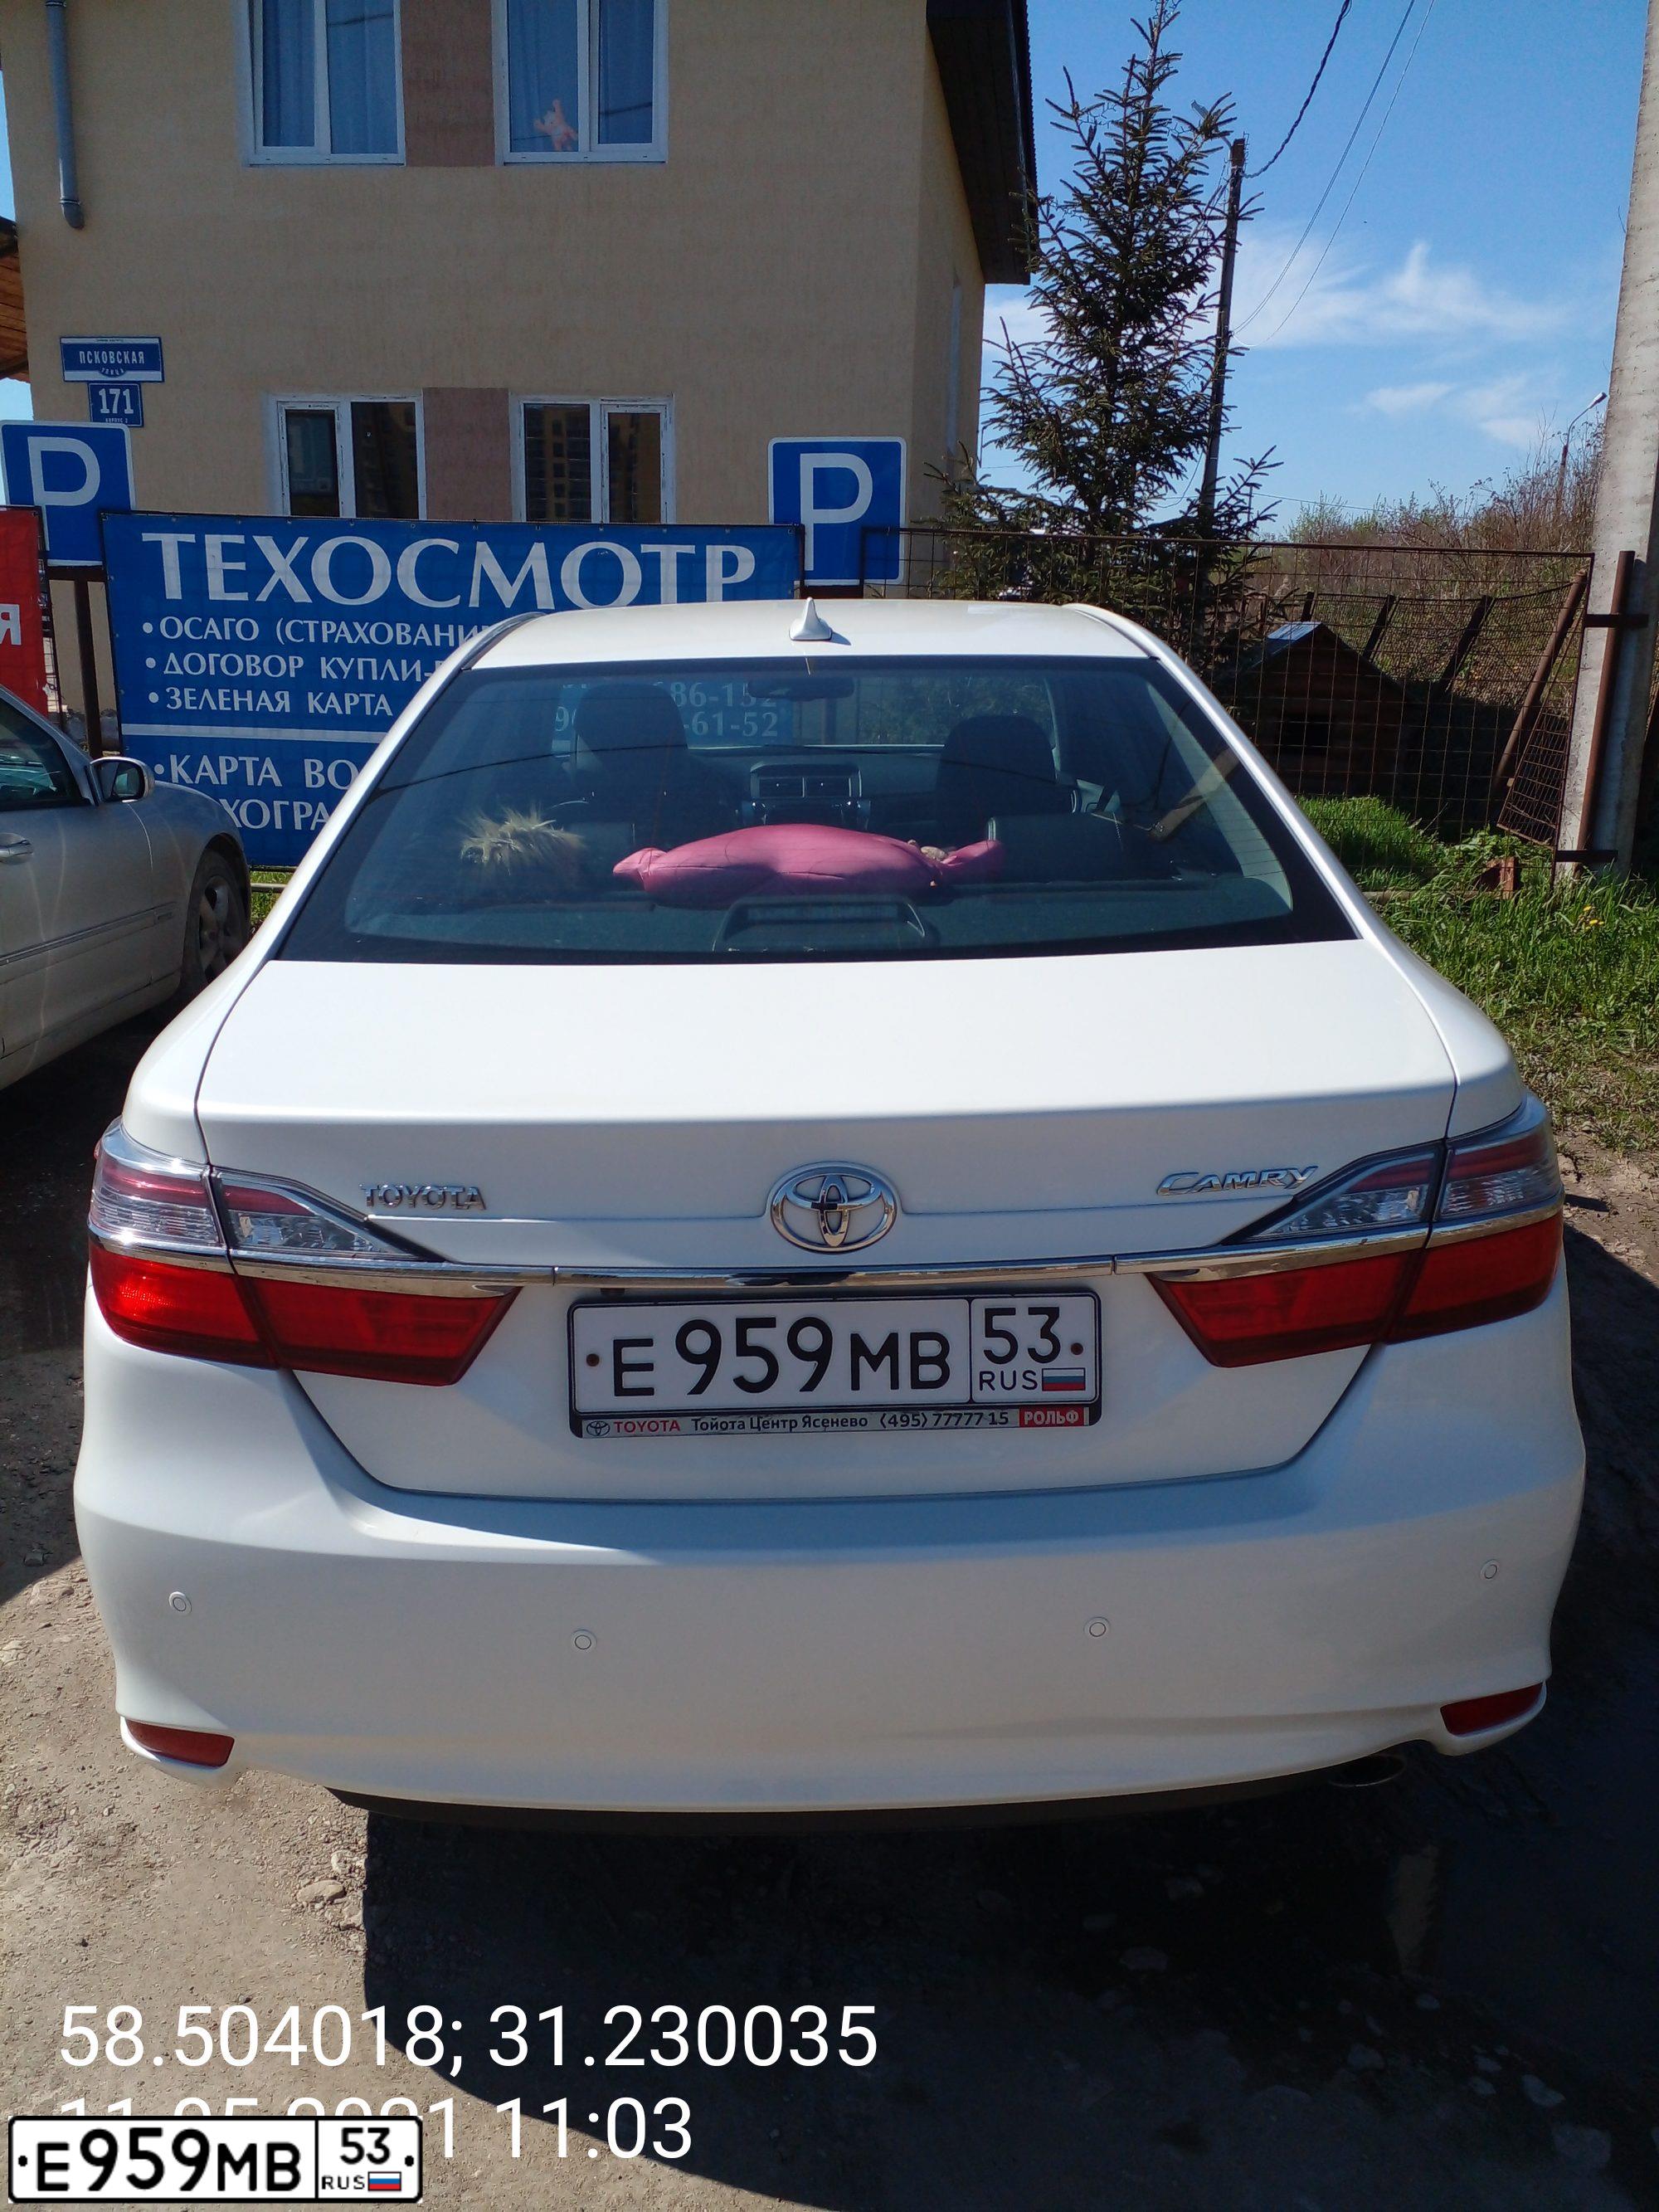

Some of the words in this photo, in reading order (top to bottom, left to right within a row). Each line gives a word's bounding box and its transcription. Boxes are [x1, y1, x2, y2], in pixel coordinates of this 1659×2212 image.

[79, 350, 145, 364] ПСКОВСКАЯ
[99, 387, 134, 414] 171
[800, 453, 873, 571] P
[142, 533, 755, 611] ТЕХОСМОТР
[159, 616, 260, 641] ОСАГО
[276, 617, 493, 647] (СТРАХОВАНИ
[163, 652, 304, 678] ДОГОВОР
[320, 656, 443, 682] КУПЛИ-
[166, 687, 290, 713] ЗЕЛЕНАЯ
[308, 691, 393, 716] КАРТА
[170, 754, 283, 787] КАРТА
[1156, 1166, 1319, 1196] CAMRY
[361, 1183, 486, 1211] TOYOTA
[983, 1307, 1062, 1365] 53
[979, 1369, 1039, 1391] RUS
[614, 1419, 681, 1434] TOYOTA
[691, 1417, 746, 1433] Тойота
[749, 1415, 798, 1433] Центр
[801, 1414, 868, 1431] Ясенево
[1023, 1410, 1080, 1426] РОЛЬФ
